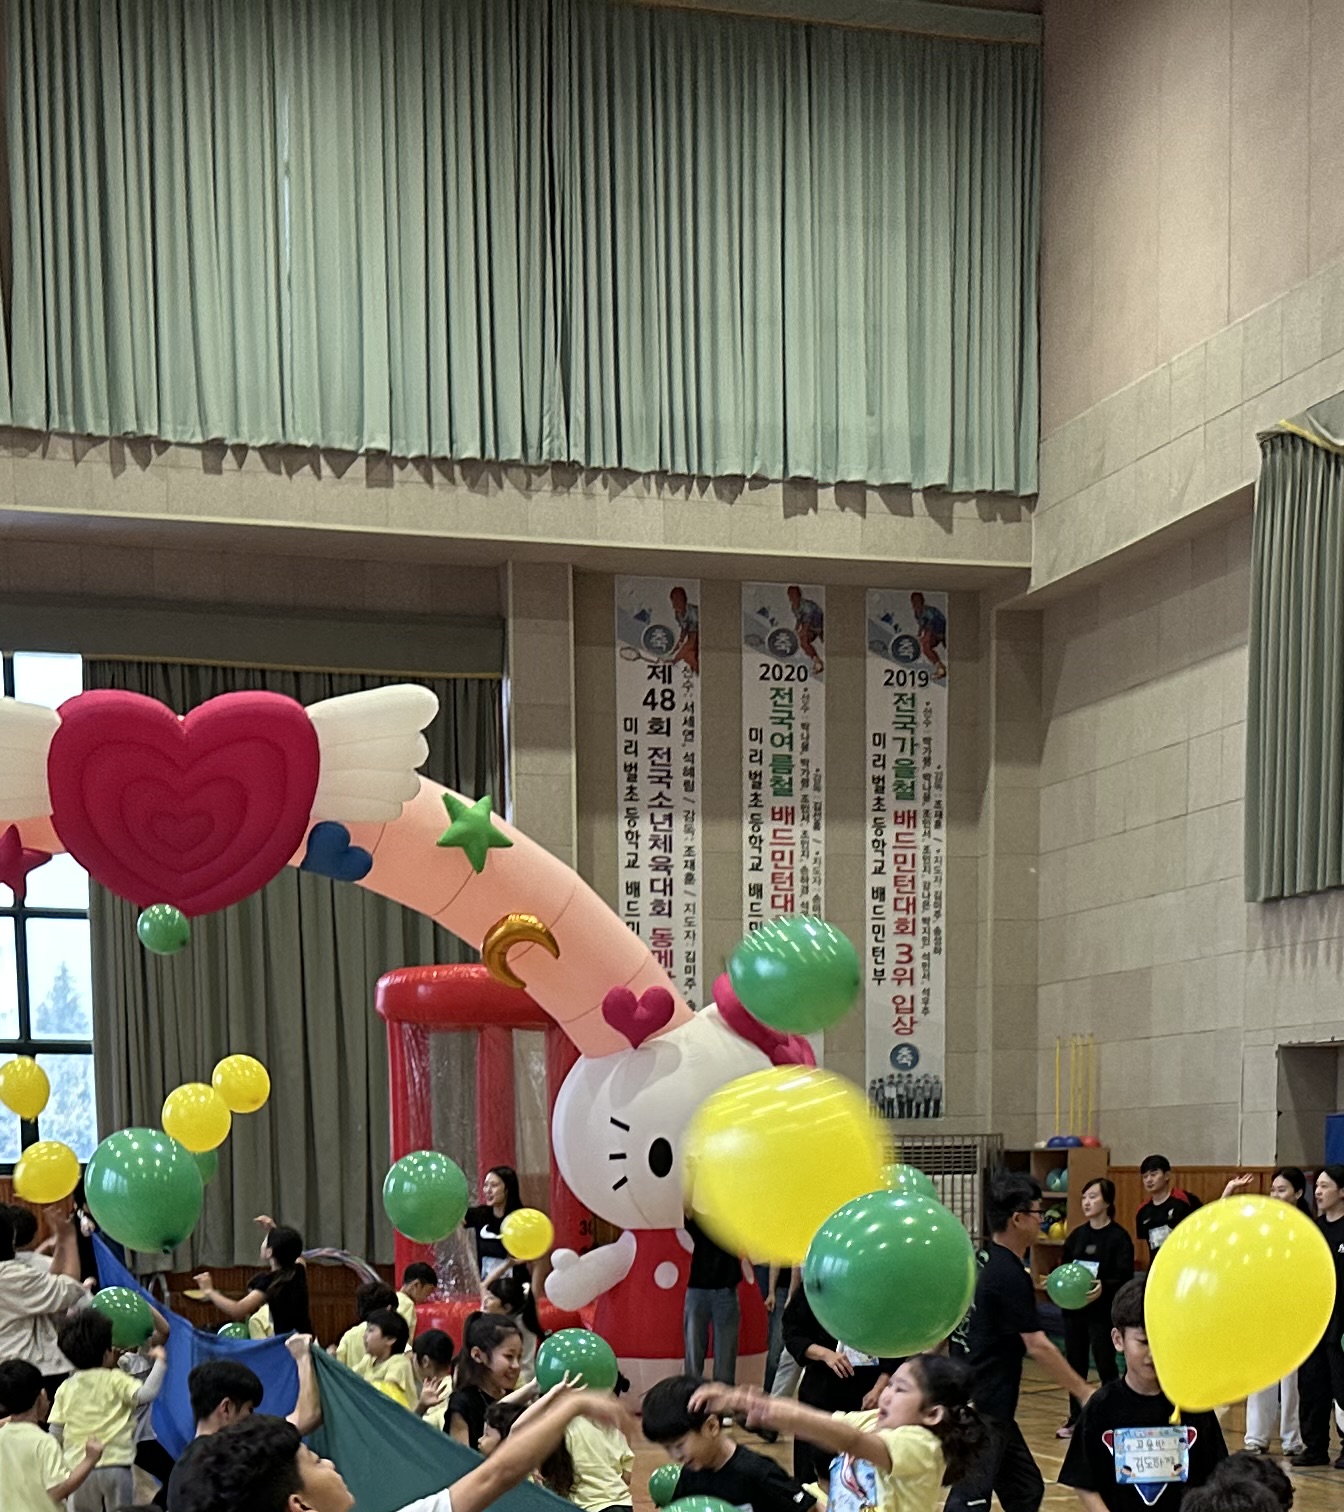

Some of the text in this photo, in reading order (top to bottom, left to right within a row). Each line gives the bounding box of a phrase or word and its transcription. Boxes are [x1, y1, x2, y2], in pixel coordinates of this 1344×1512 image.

[759, 664, 808, 682] 2020
[883, 669, 929, 687] 2019
[623, 717, 640, 869] 미리벌초등학교
[646, 747, 674, 918] 전국소년체육대회
[748, 727, 763, 872] 미리벌초등학교
[769, 687, 796, 917] 전국여름철 배드민턴대
[871, 732, 886, 986] 미리벌초등학교 배드민턴부
[891, 692, 918, 1036] 전국가을철 배드민턴대회 3위 입상
